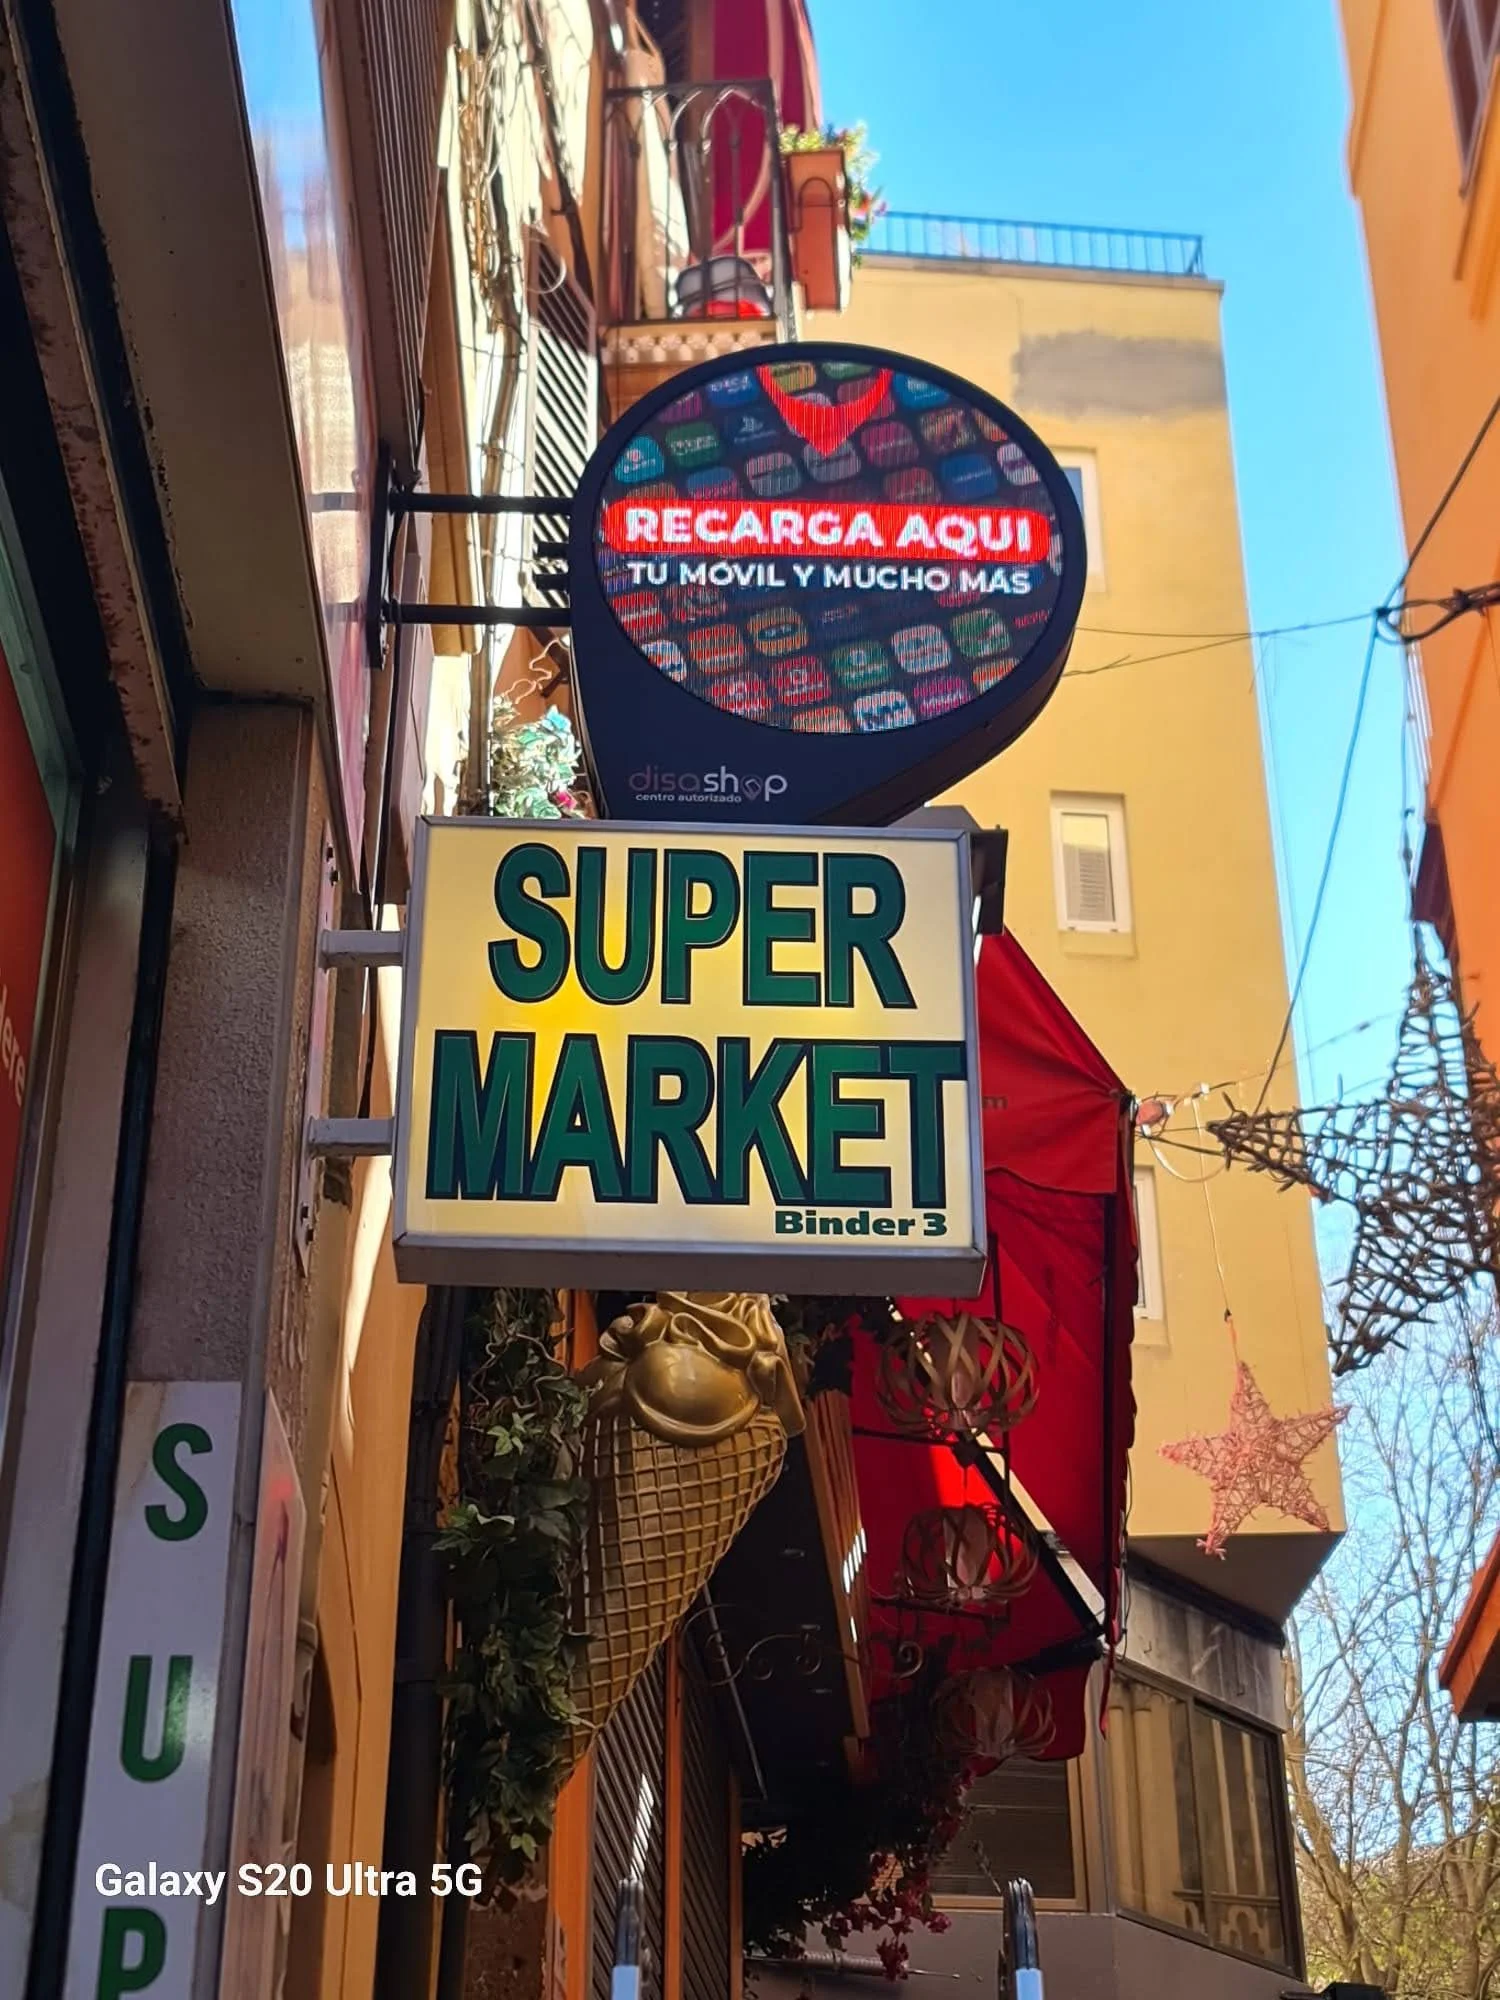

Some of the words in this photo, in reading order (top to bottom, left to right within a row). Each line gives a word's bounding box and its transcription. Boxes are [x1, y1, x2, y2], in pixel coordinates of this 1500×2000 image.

[624, 507, 883, 549] RECARGA
[896, 512, 1032, 558] AQUI
[627, 561, 668, 586] TU
[793, 562, 815, 588] Y
[823, 564, 950, 592] MUCHO
[635, 792, 676, 802] centro
[678, 791, 742, 804] autorizado
[488, 842, 918, 1009] SUPER
[425, 1029, 967, 1209] MARKET
[775, 1209, 916, 1236] Binder
[923, 1212, 948, 1236] 3
